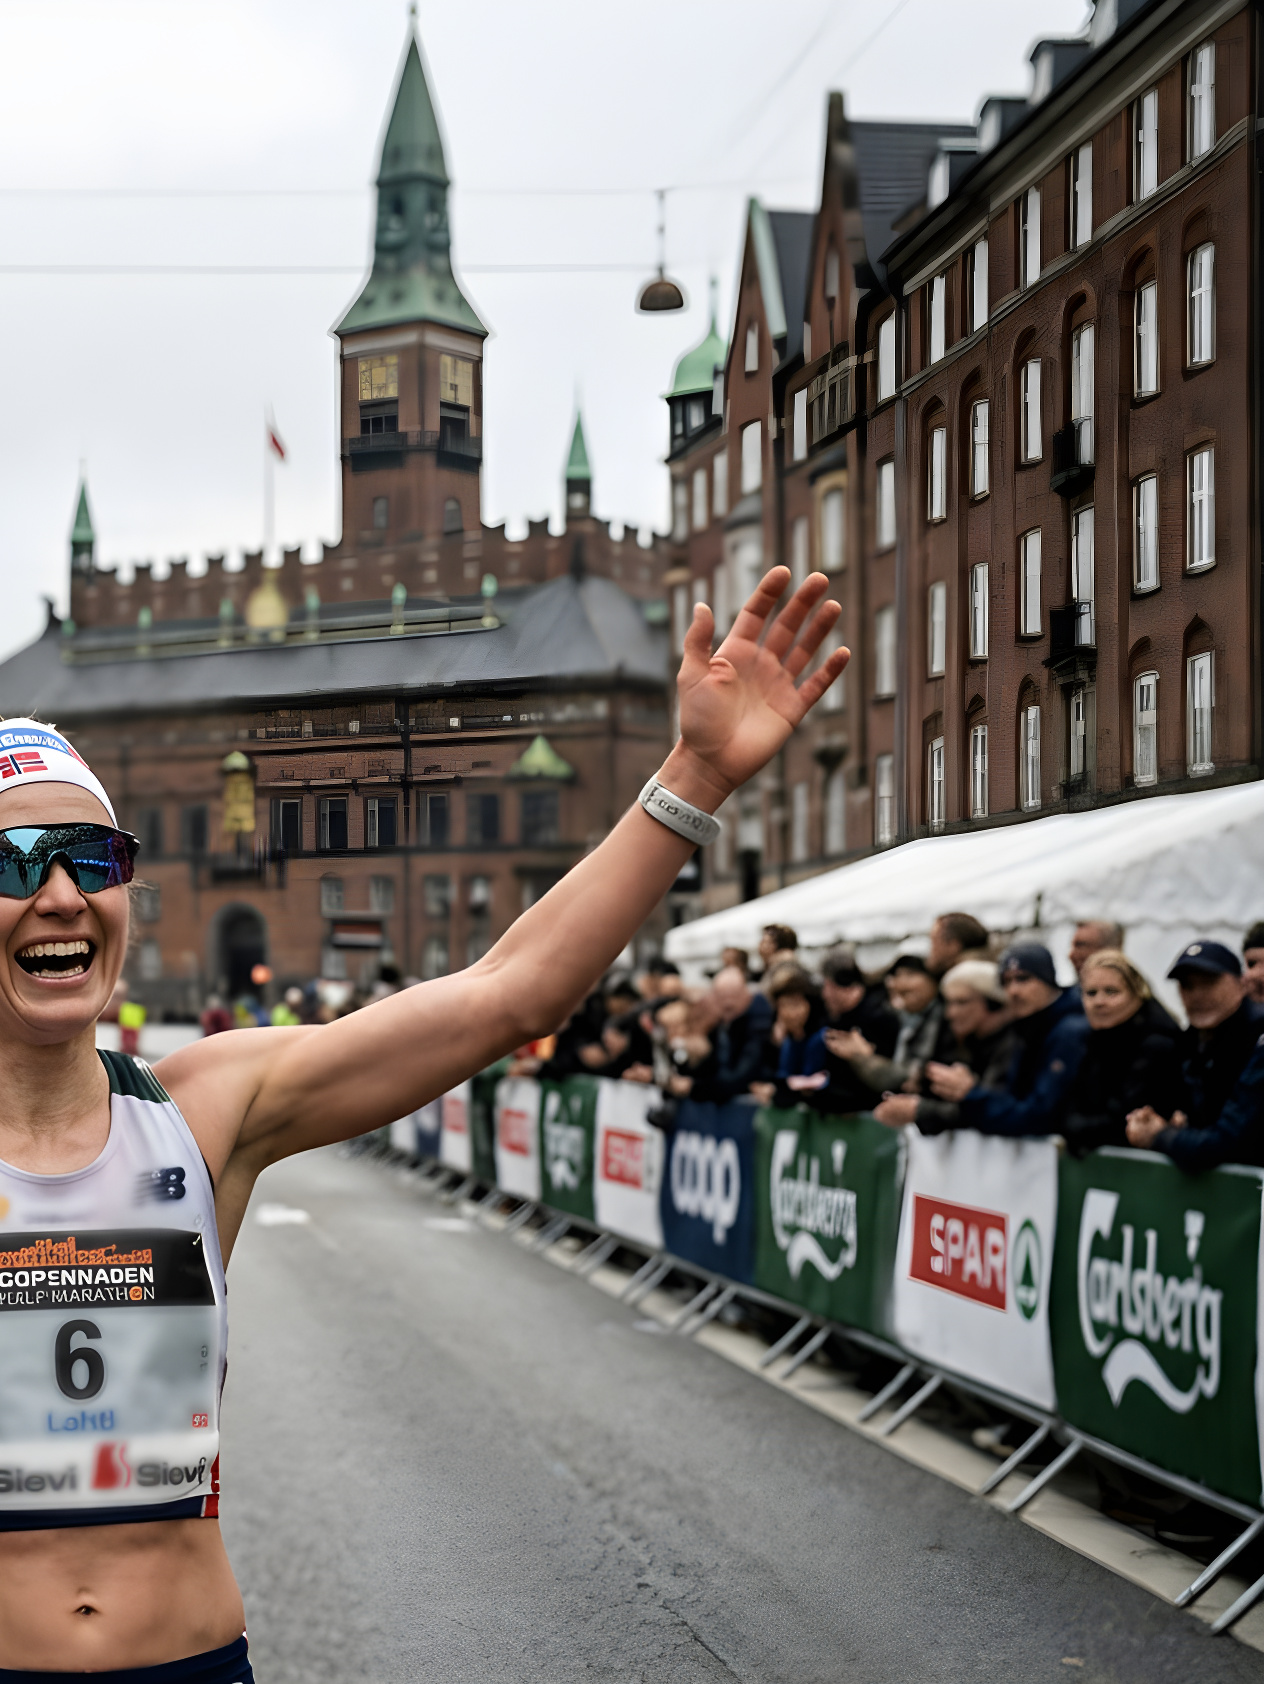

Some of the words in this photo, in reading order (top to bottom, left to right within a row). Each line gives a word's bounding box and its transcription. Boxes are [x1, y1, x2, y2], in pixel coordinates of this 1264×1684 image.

[670, 1130, 740, 1245] coop
[930, 1213, 1006, 1293] SPAR
[1077, 1188, 1223, 1399] Carlsberg
[54, 1319, 105, 1400] 6
